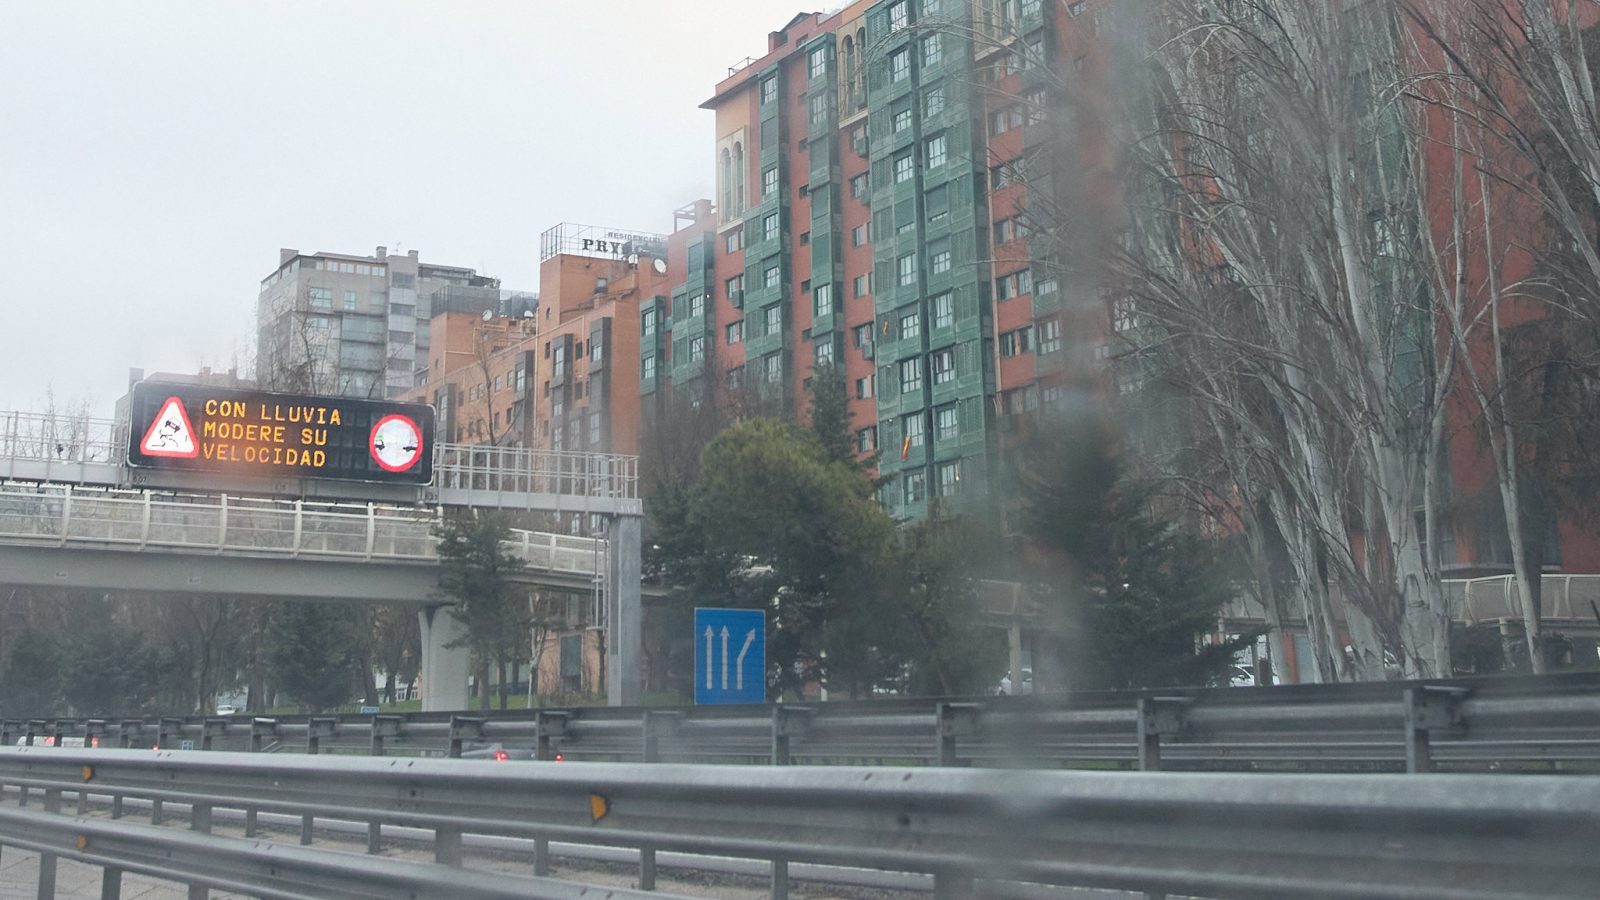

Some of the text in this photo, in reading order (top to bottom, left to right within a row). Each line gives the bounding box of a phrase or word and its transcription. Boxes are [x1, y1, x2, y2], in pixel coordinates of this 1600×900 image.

[205, 399, 341, 425] CON LLUVIA
[204, 421, 327, 446] MODERE SU
[203, 442, 326, 467] VELOCIDAD
